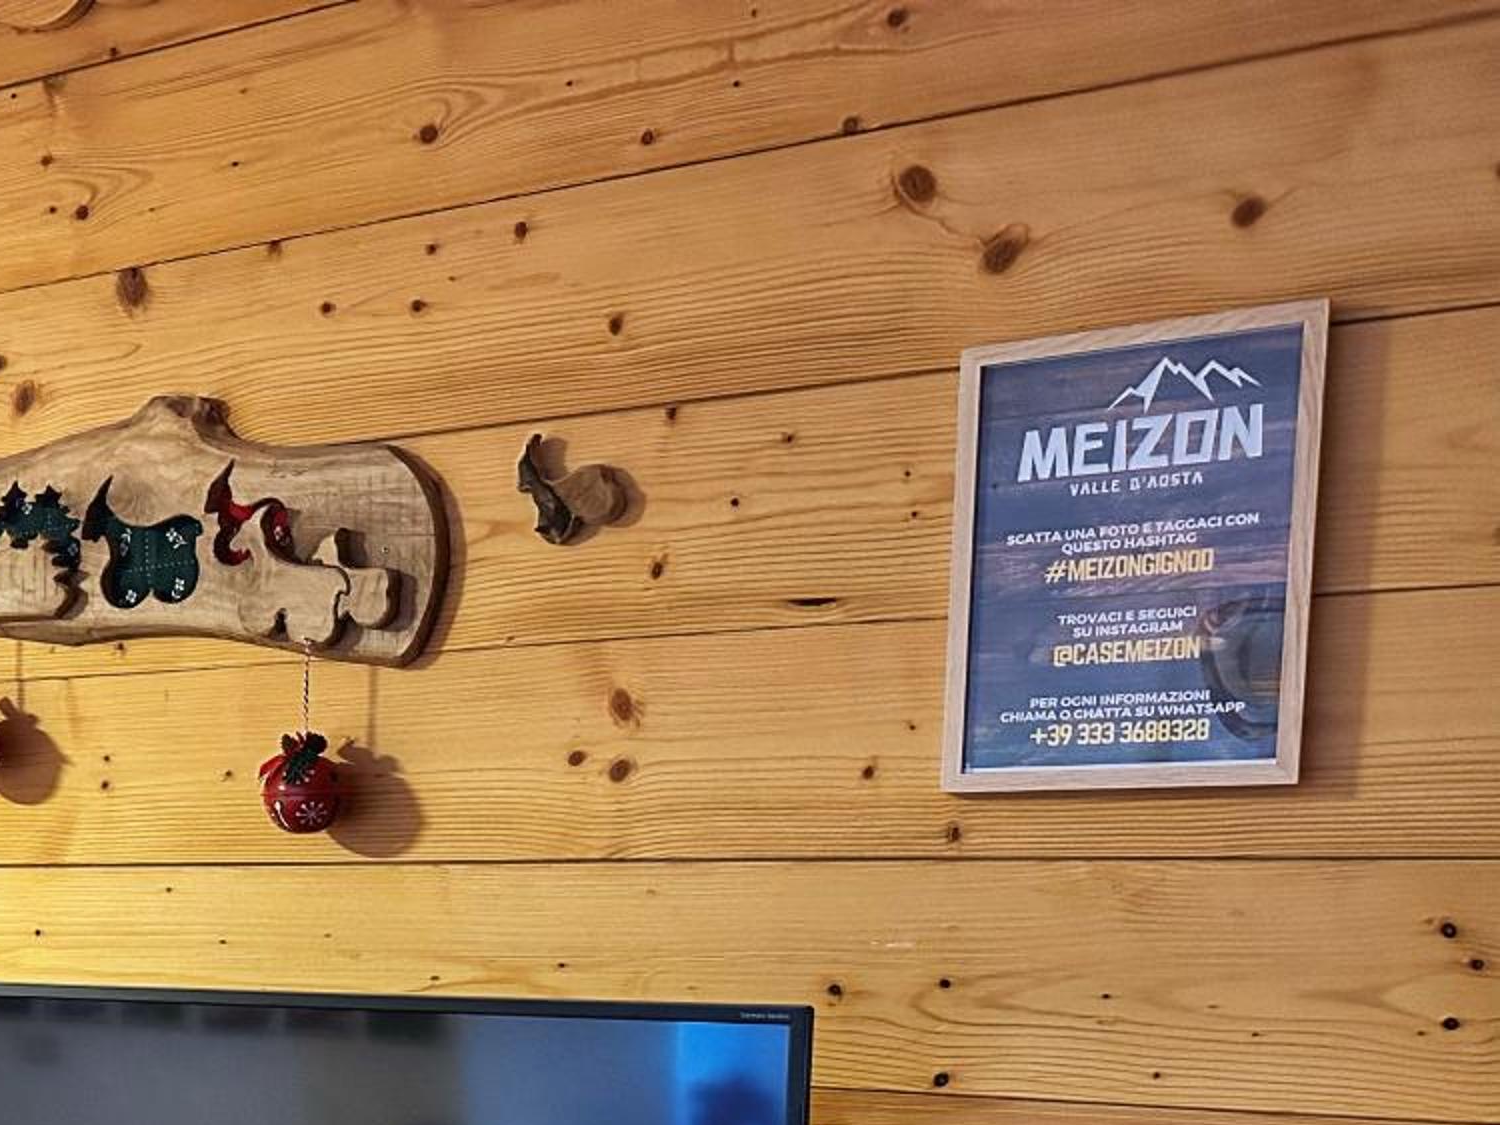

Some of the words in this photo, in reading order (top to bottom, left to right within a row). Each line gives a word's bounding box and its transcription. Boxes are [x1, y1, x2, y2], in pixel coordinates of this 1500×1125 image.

[1017, 403, 1264, 483] MEIZON
[1070, 478, 1120, 497] VALLE
[1130, 470, 1204, 492] D'AOSTA
[1006, 531, 1062, 547] SCATTA
[1064, 524, 1096, 542] UNA
[1099, 521, 1140, 540] FOTO
[1142, 520, 1153, 534] E
[1225, 512, 1260, 526] CON
[1061, 538, 1122, 556] QUESTO
[1123, 532, 1198, 549] HASHTAG
[1057, 611, 1122, 626] TROVACI
[1125, 609, 1135, 622] E
[1138, 605, 1197, 621] SEGUICI
[1072, 625, 1092, 639] SU
[1095, 620, 1184, 637] INSTAGRAM
[1053, 635, 1201, 668] @CASEMEIZON
[1030, 697, 1059, 709] PER
[1061, 694, 1098, 709] OGNI
[1100, 689, 1211, 706] INFORMAZIONI
[1000, 711, 1057, 724] CHIAMA
[1059, 709, 1072, 721] O
[1074, 706, 1133, 721] CHATTA
[1135, 703, 1156, 717] SU
[1159, 700, 1247, 717] WHATSAPP
[1030, 723, 1074, 748] +39
[1077, 721, 1116, 746] 333
